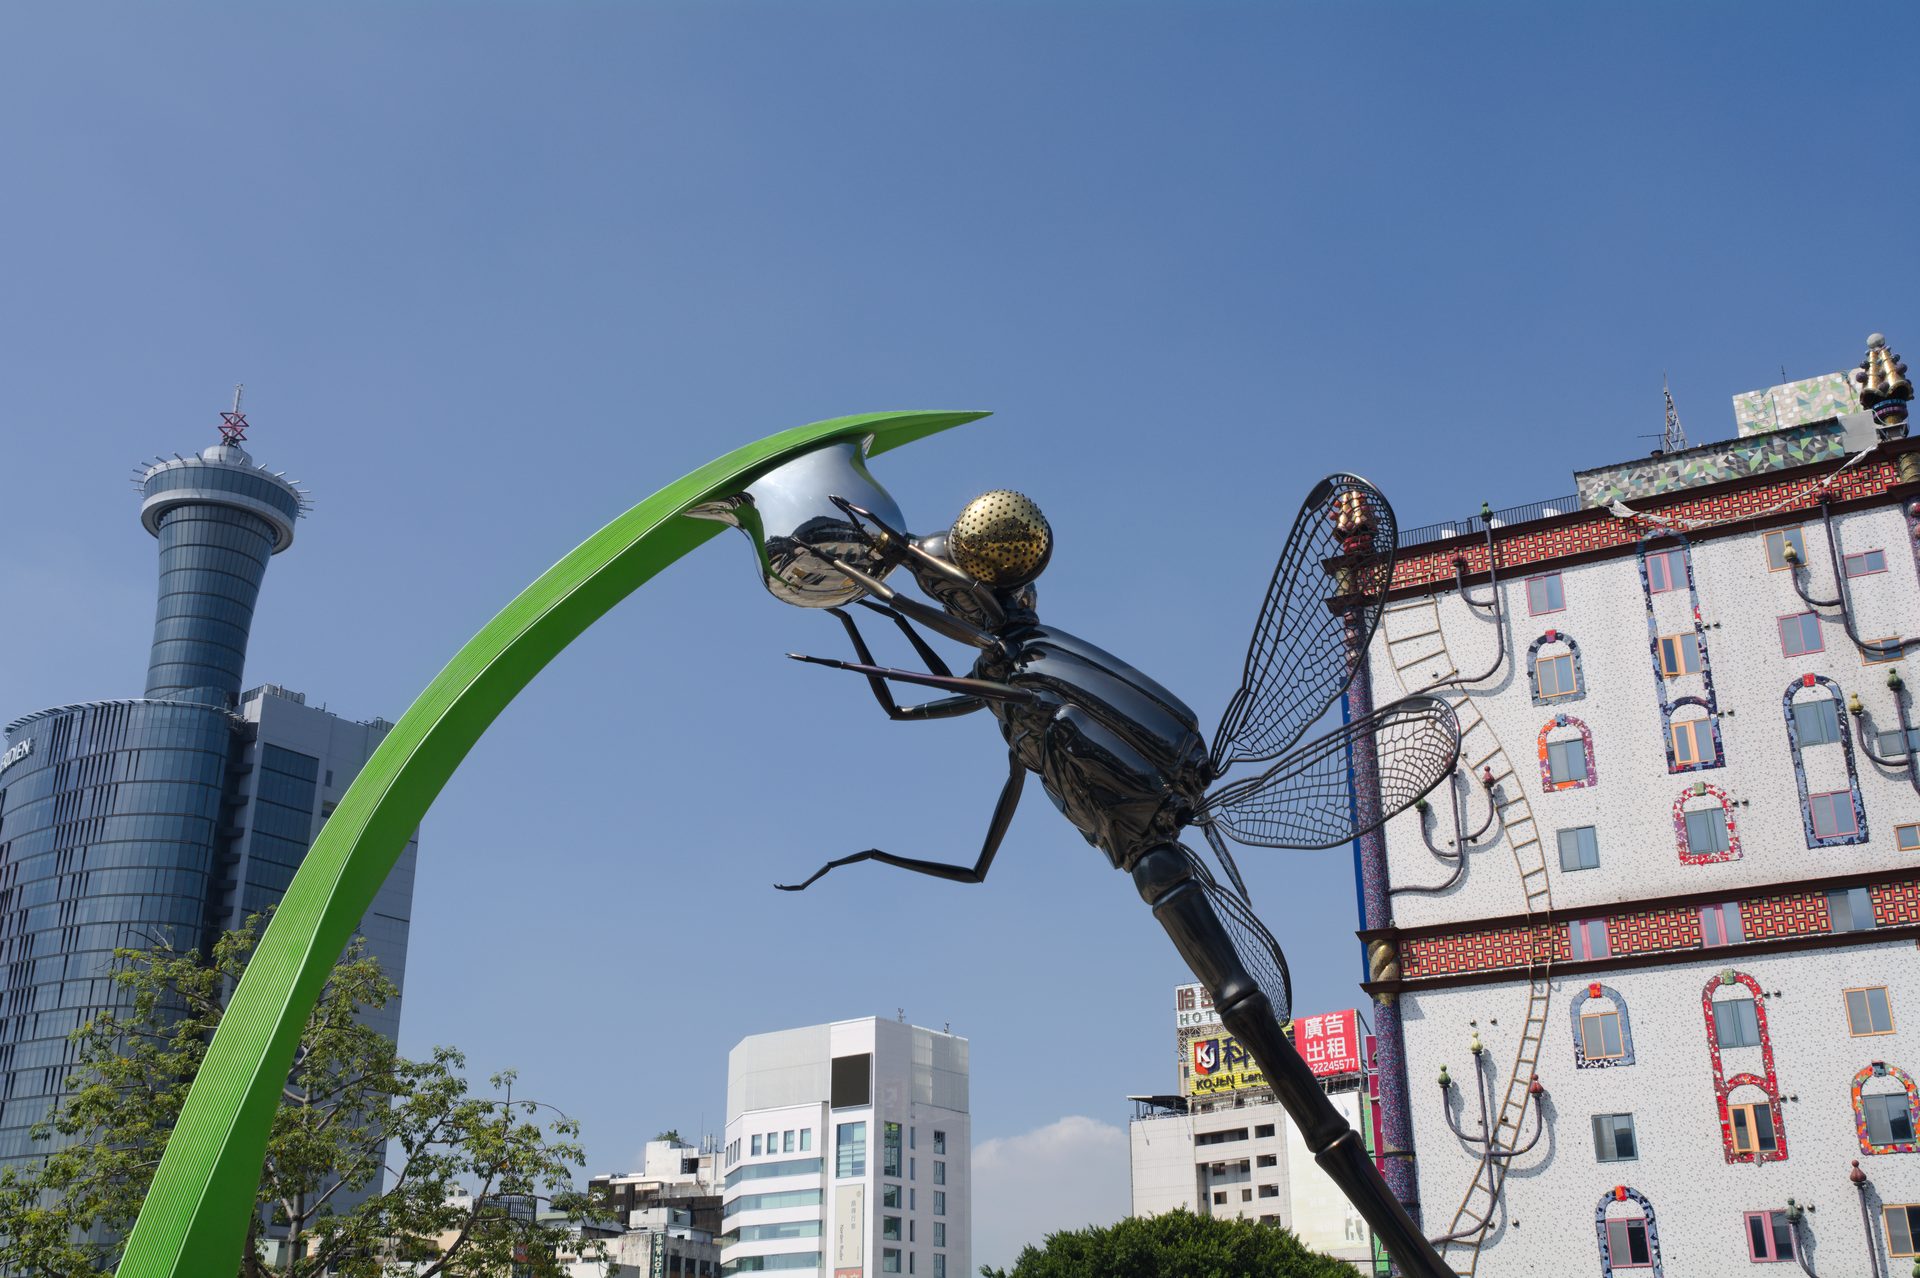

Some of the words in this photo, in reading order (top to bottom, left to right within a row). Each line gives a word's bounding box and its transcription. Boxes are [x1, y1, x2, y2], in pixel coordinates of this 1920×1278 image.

[1305, 1014, 1344, 1039] 廣告
[1306, 1037, 1347, 1062] 出租
[1196, 1074, 1235, 1091] KOJEN
